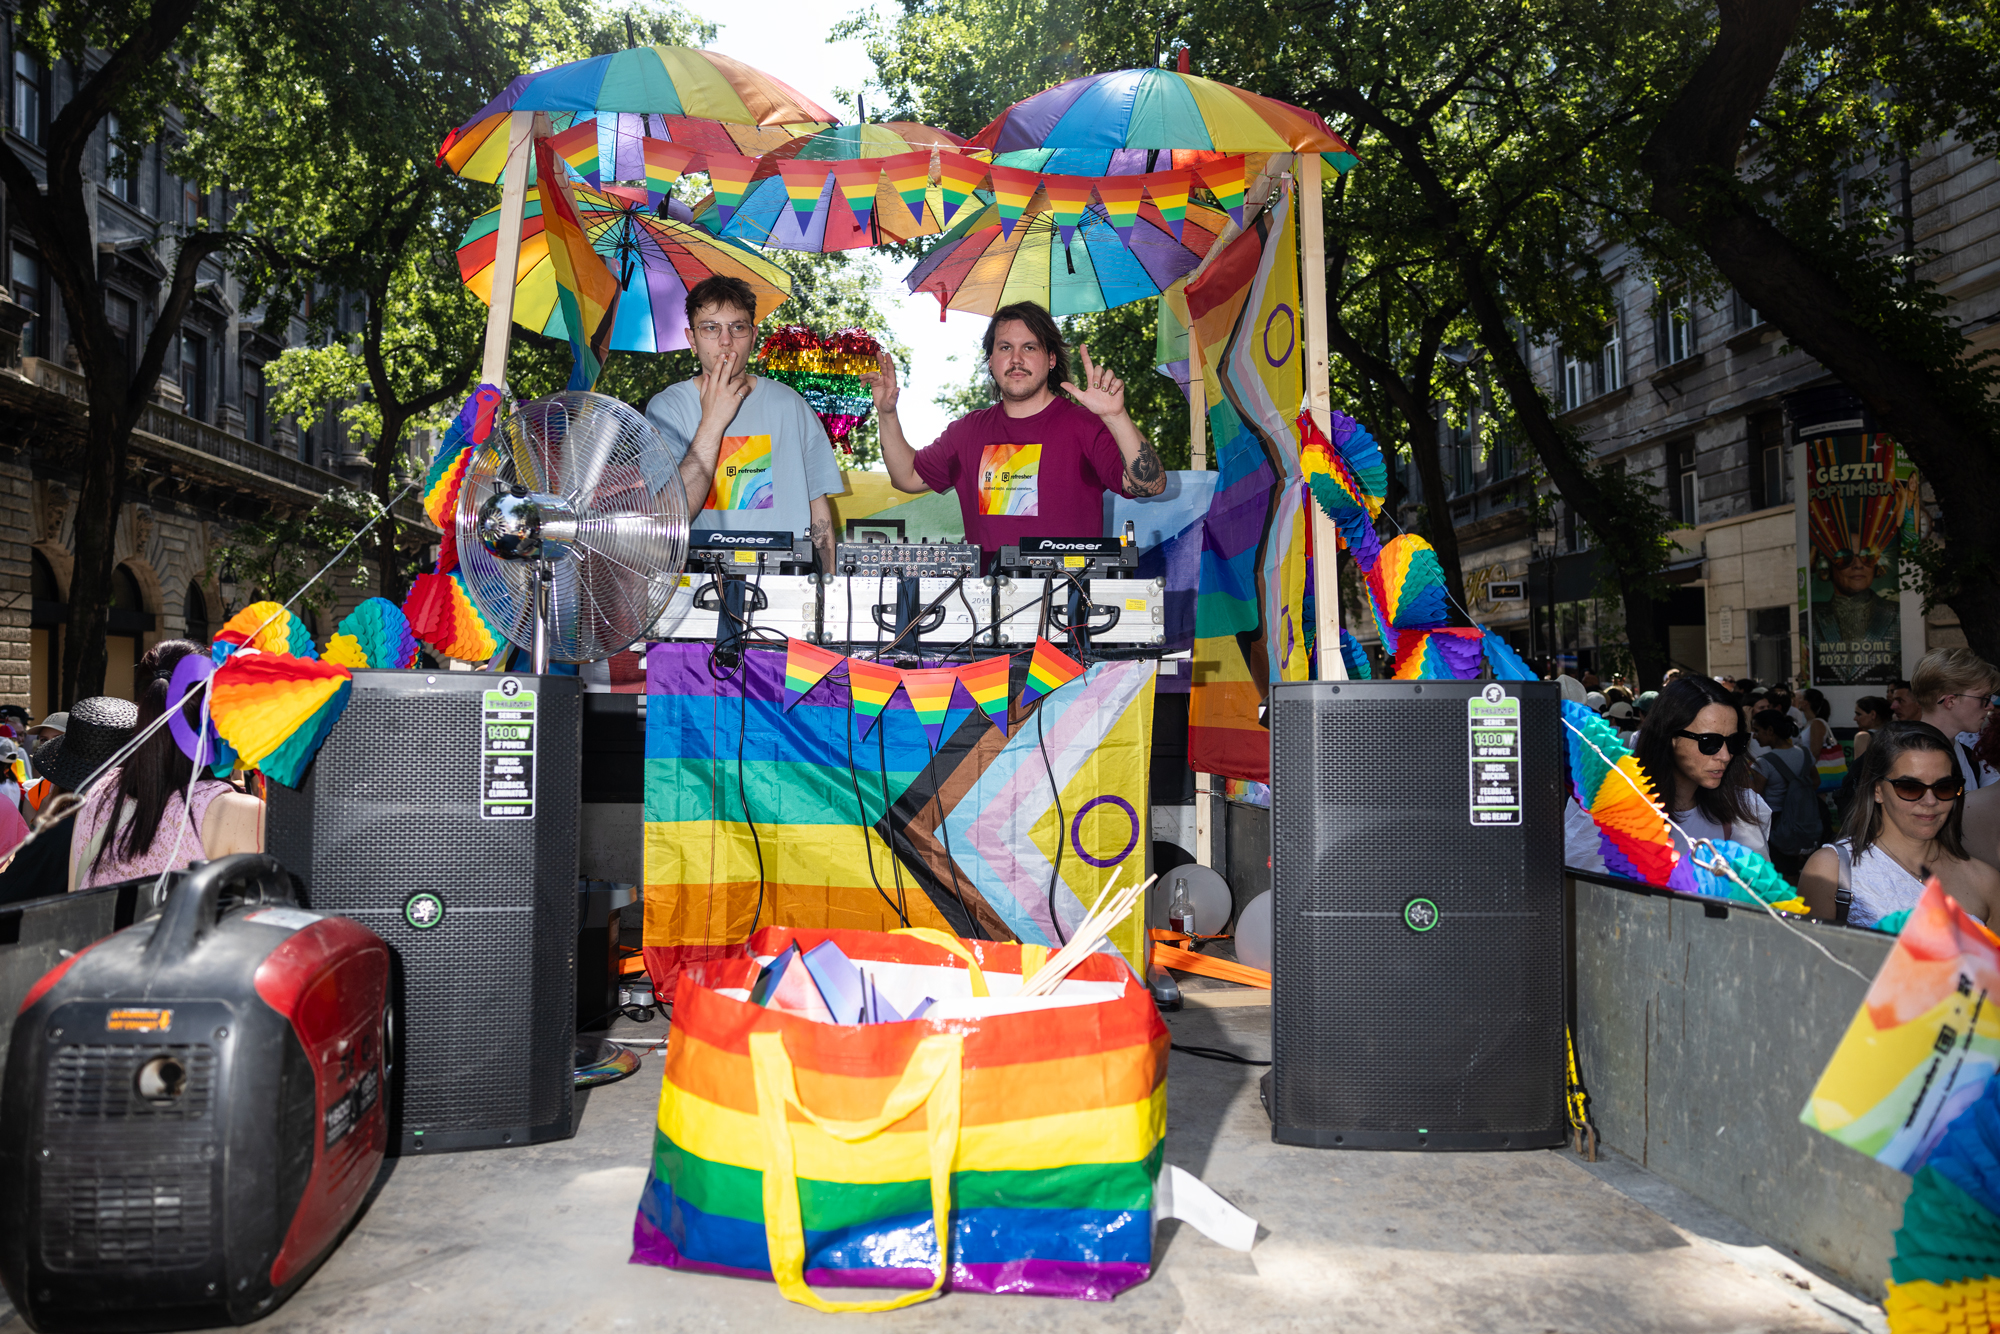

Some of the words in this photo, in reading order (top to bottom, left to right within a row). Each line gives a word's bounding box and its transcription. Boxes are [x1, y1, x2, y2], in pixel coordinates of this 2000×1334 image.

[1816, 462, 1884, 485] GESZTI
[1809, 481, 1895, 501] POPTIMISTA
[708, 533, 774, 544] Pioneer
[1039, 540, 1102, 550] Pioneer
[1819, 642, 1846, 652] MVM
[1851, 641, 1891, 652] DOME
[1473, 707, 1515, 715] THUMP
[488, 726, 530, 739] 1400W
[493, 741, 502, 749] OF
[502, 741, 526, 749] POWER
[1474, 733, 1514, 746] 1400W
[1485, 764, 1506, 772] MUSIC
